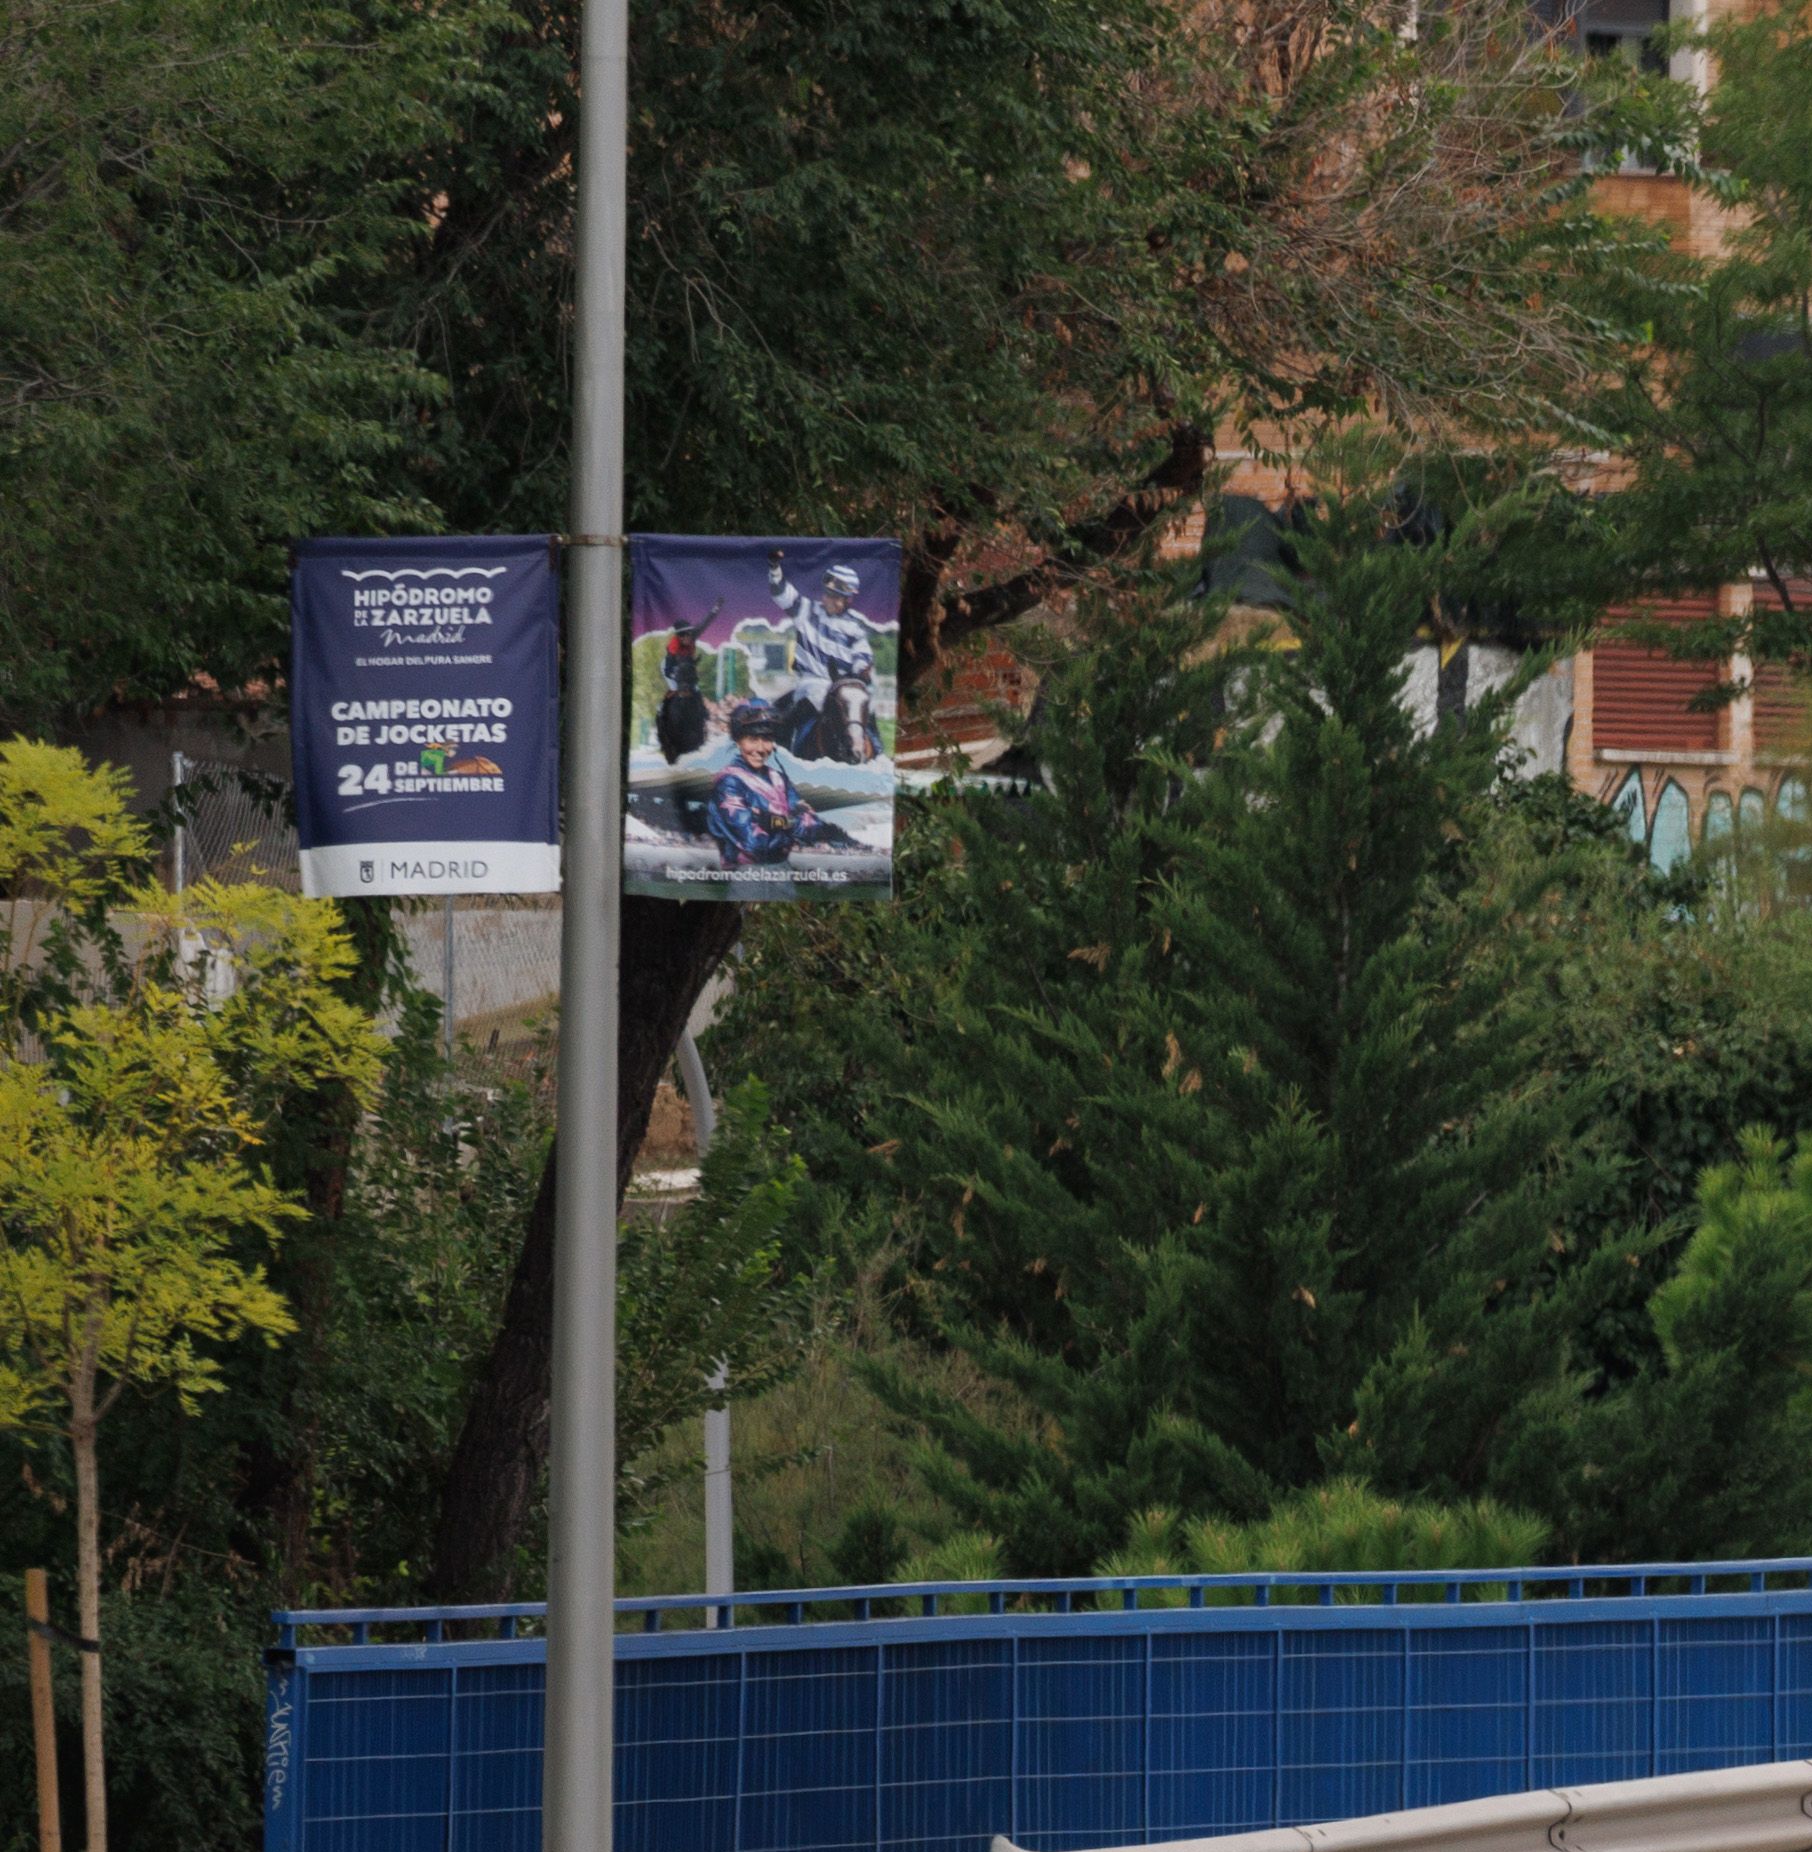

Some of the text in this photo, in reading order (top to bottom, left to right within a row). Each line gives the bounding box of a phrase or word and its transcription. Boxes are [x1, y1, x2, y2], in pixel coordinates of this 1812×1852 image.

[354, 583, 493, 606] HIPÓDROMO
[354, 610, 367, 618] DE
[370, 607, 493, 626] ZARZUELA
[368, 656, 404, 666] HOGAR
[424, 655, 452, 665] PURA
[331, 698, 512, 721] CAMPEONATO
[337, 723, 507, 745] DE JOCKETAS
[337, 762, 504, 796] 24 DE SEPTIEMBRE
[391, 861, 488, 879] MADRID
